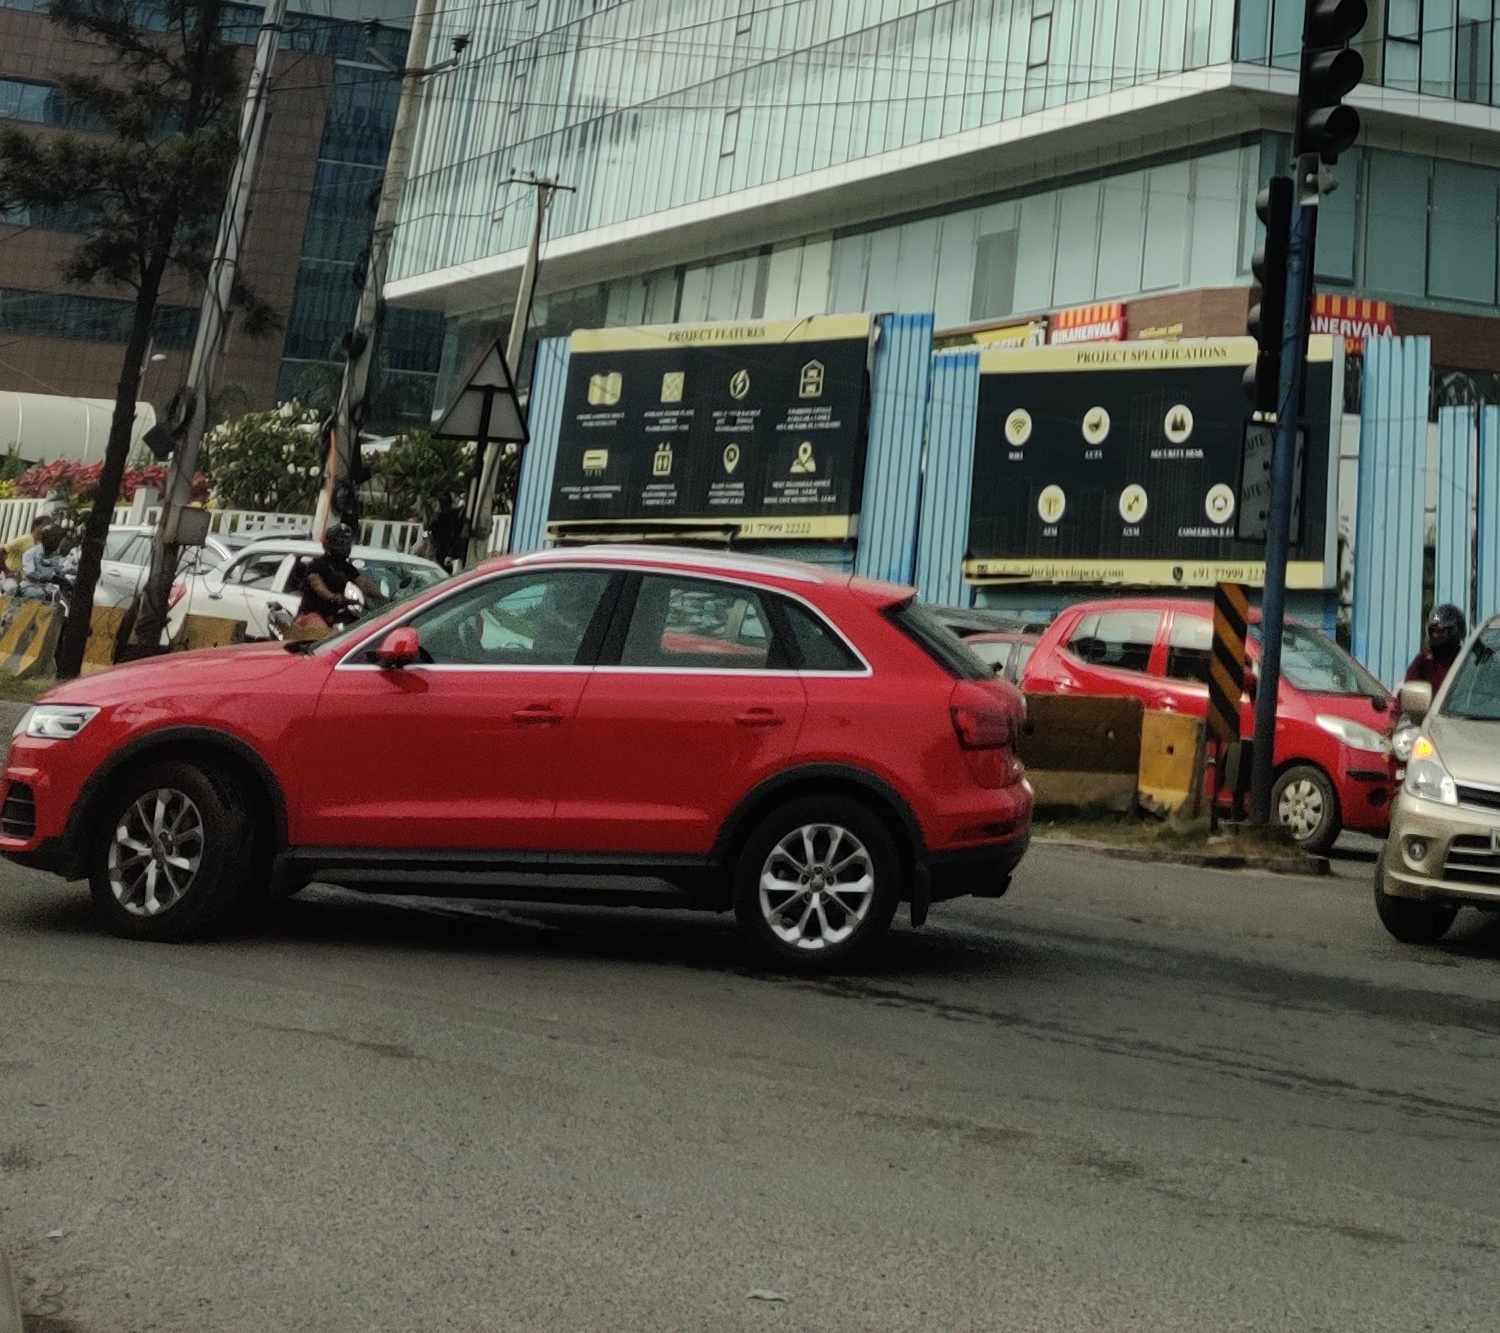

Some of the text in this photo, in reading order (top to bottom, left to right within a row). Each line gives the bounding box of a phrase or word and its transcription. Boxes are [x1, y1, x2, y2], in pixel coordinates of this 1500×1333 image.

[668, 324, 767, 342] PROJECT FEATURES
[1310, 316, 1394, 339] ANERVALA
[1076, 346, 1228, 364] PROJECT SPECIFICATIONS
